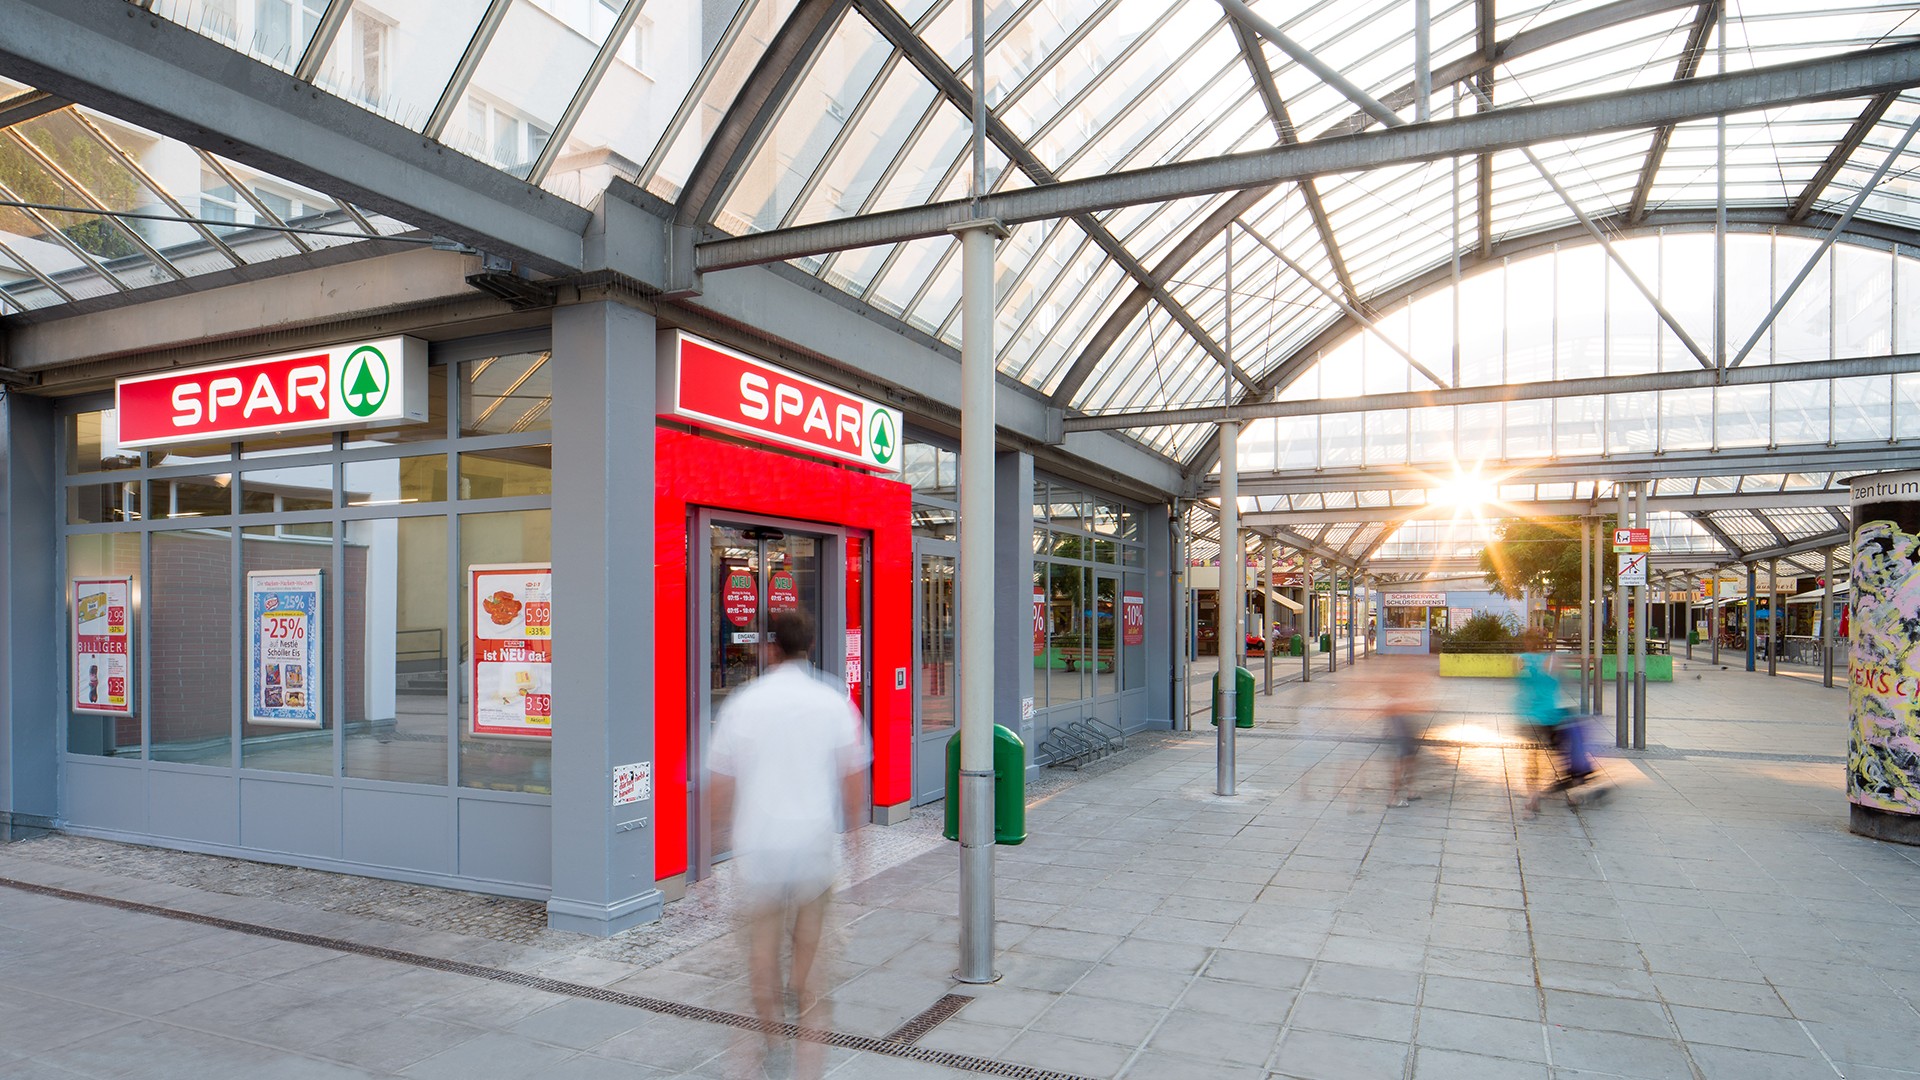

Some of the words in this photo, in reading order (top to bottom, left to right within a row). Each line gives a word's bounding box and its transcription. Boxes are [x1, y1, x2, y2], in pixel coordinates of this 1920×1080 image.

[172, 365, 327, 427] SPAR
[740, 371, 862, 448] SPAR
[732, 575, 751, 588] NEU
[775, 577, 792, 590] NEU
[279, 595, 305, 610] -25%
[108, 610, 124, 622] 2.99
[526, 608, 550, 623] 5.99
[1124, 605, 1144, 626] -10%
[264, 617, 304, 639] -25%
[528, 628, 546, 636] -33%
[78, 641, 127, 653] BILLIGER!
[484, 650, 498, 660] ist
[500, 648, 526, 661] NEU
[528, 651, 546, 662] da!
[109, 680, 124, 694] 1.35
[526, 697, 550, 710] 3.59
